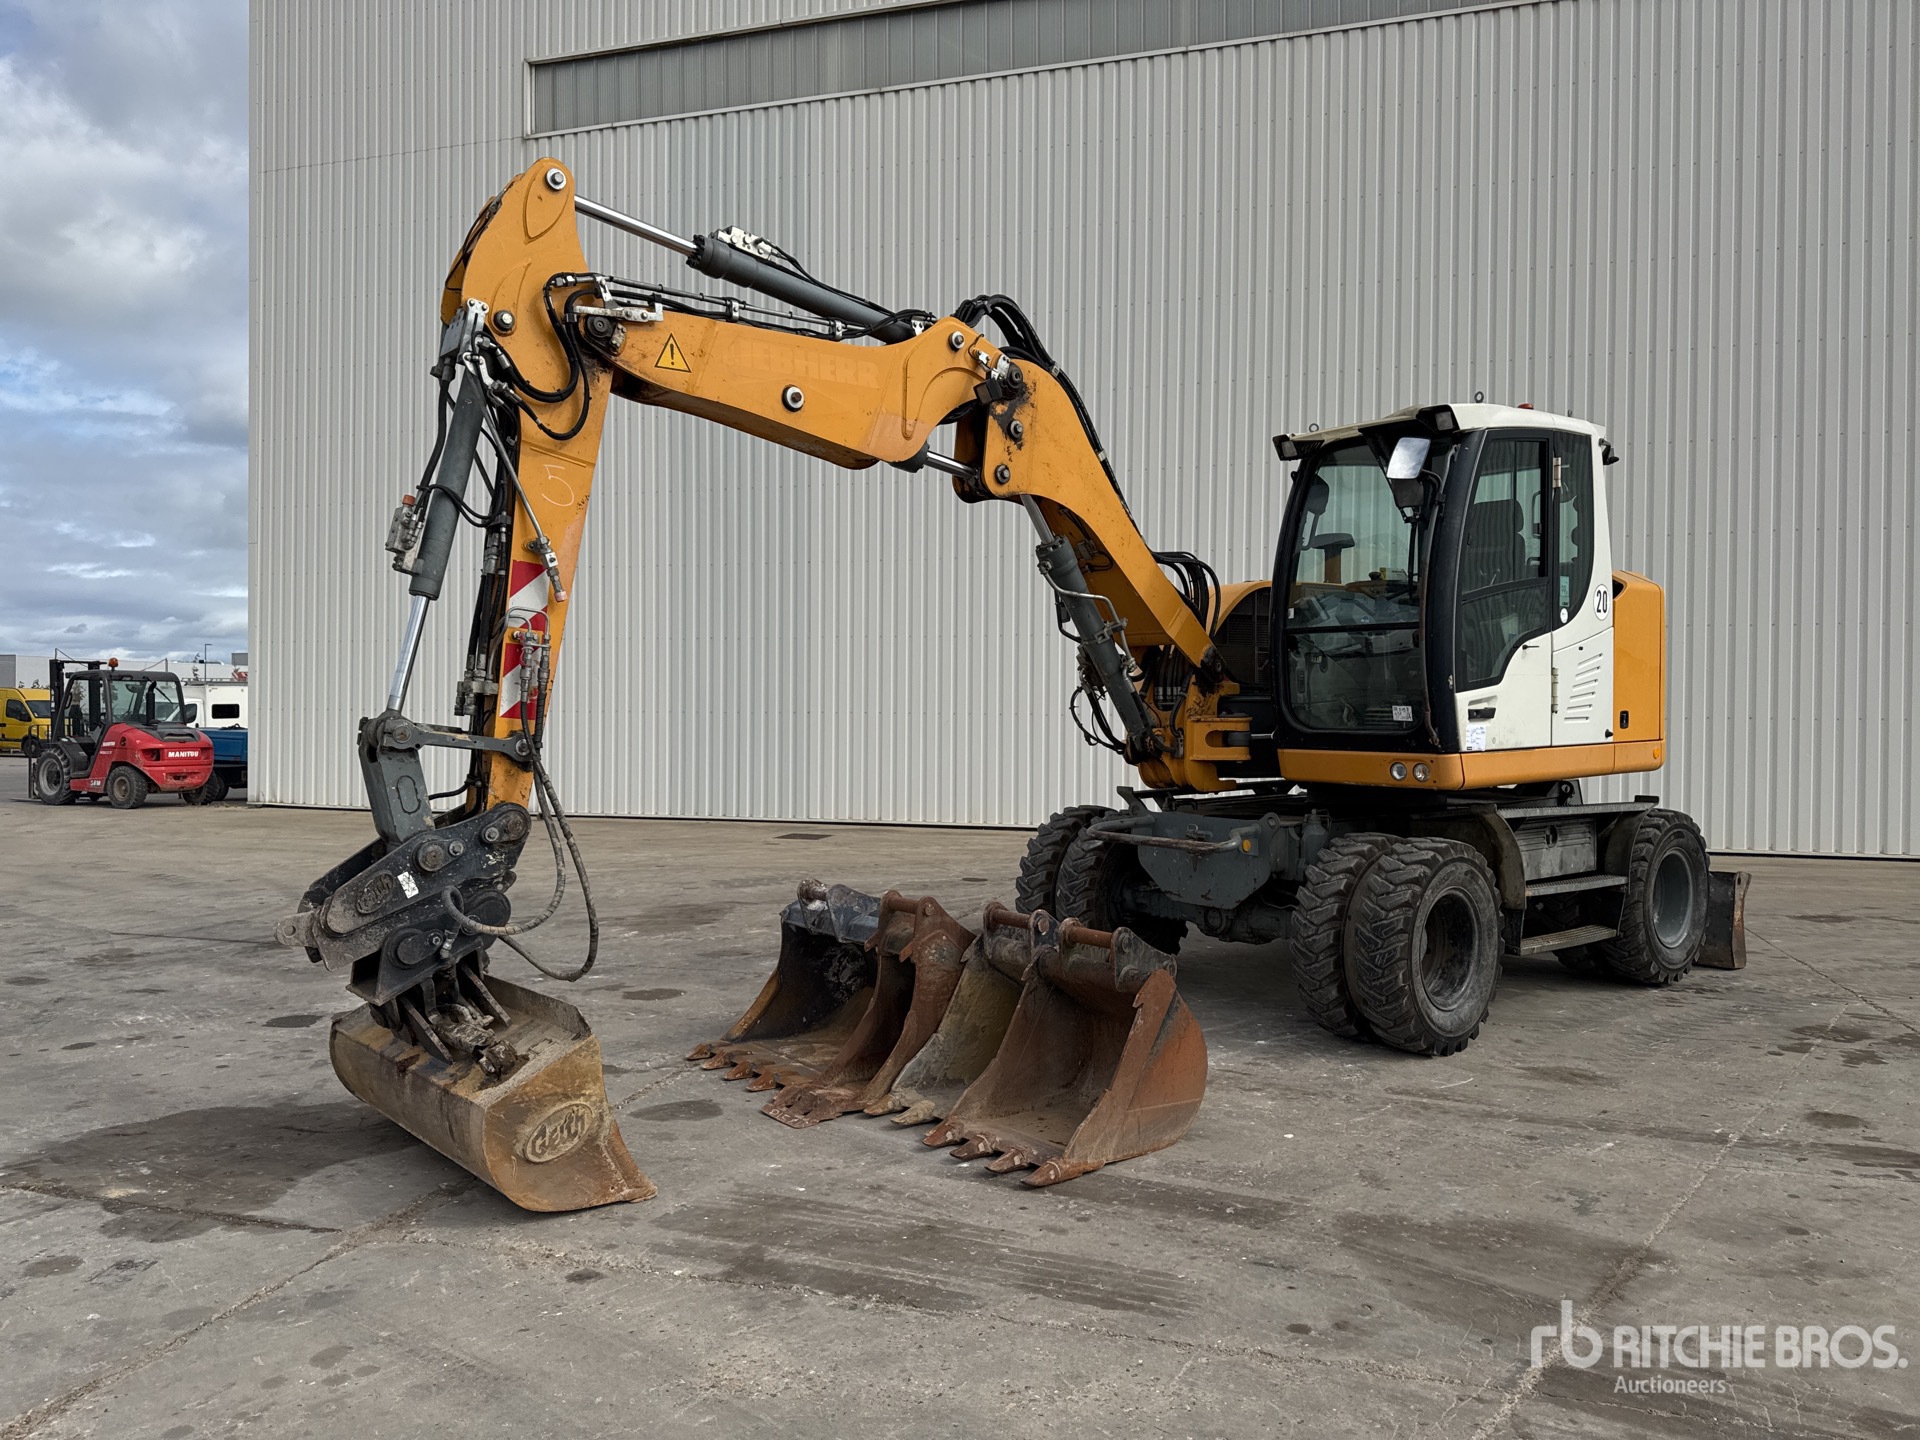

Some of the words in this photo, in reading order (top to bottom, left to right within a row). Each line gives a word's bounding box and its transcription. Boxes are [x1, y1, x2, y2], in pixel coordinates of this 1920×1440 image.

[540, 463, 575, 507] 5
[1596, 589, 1609, 614] 20
[168, 750, 199, 758] MANITOU
